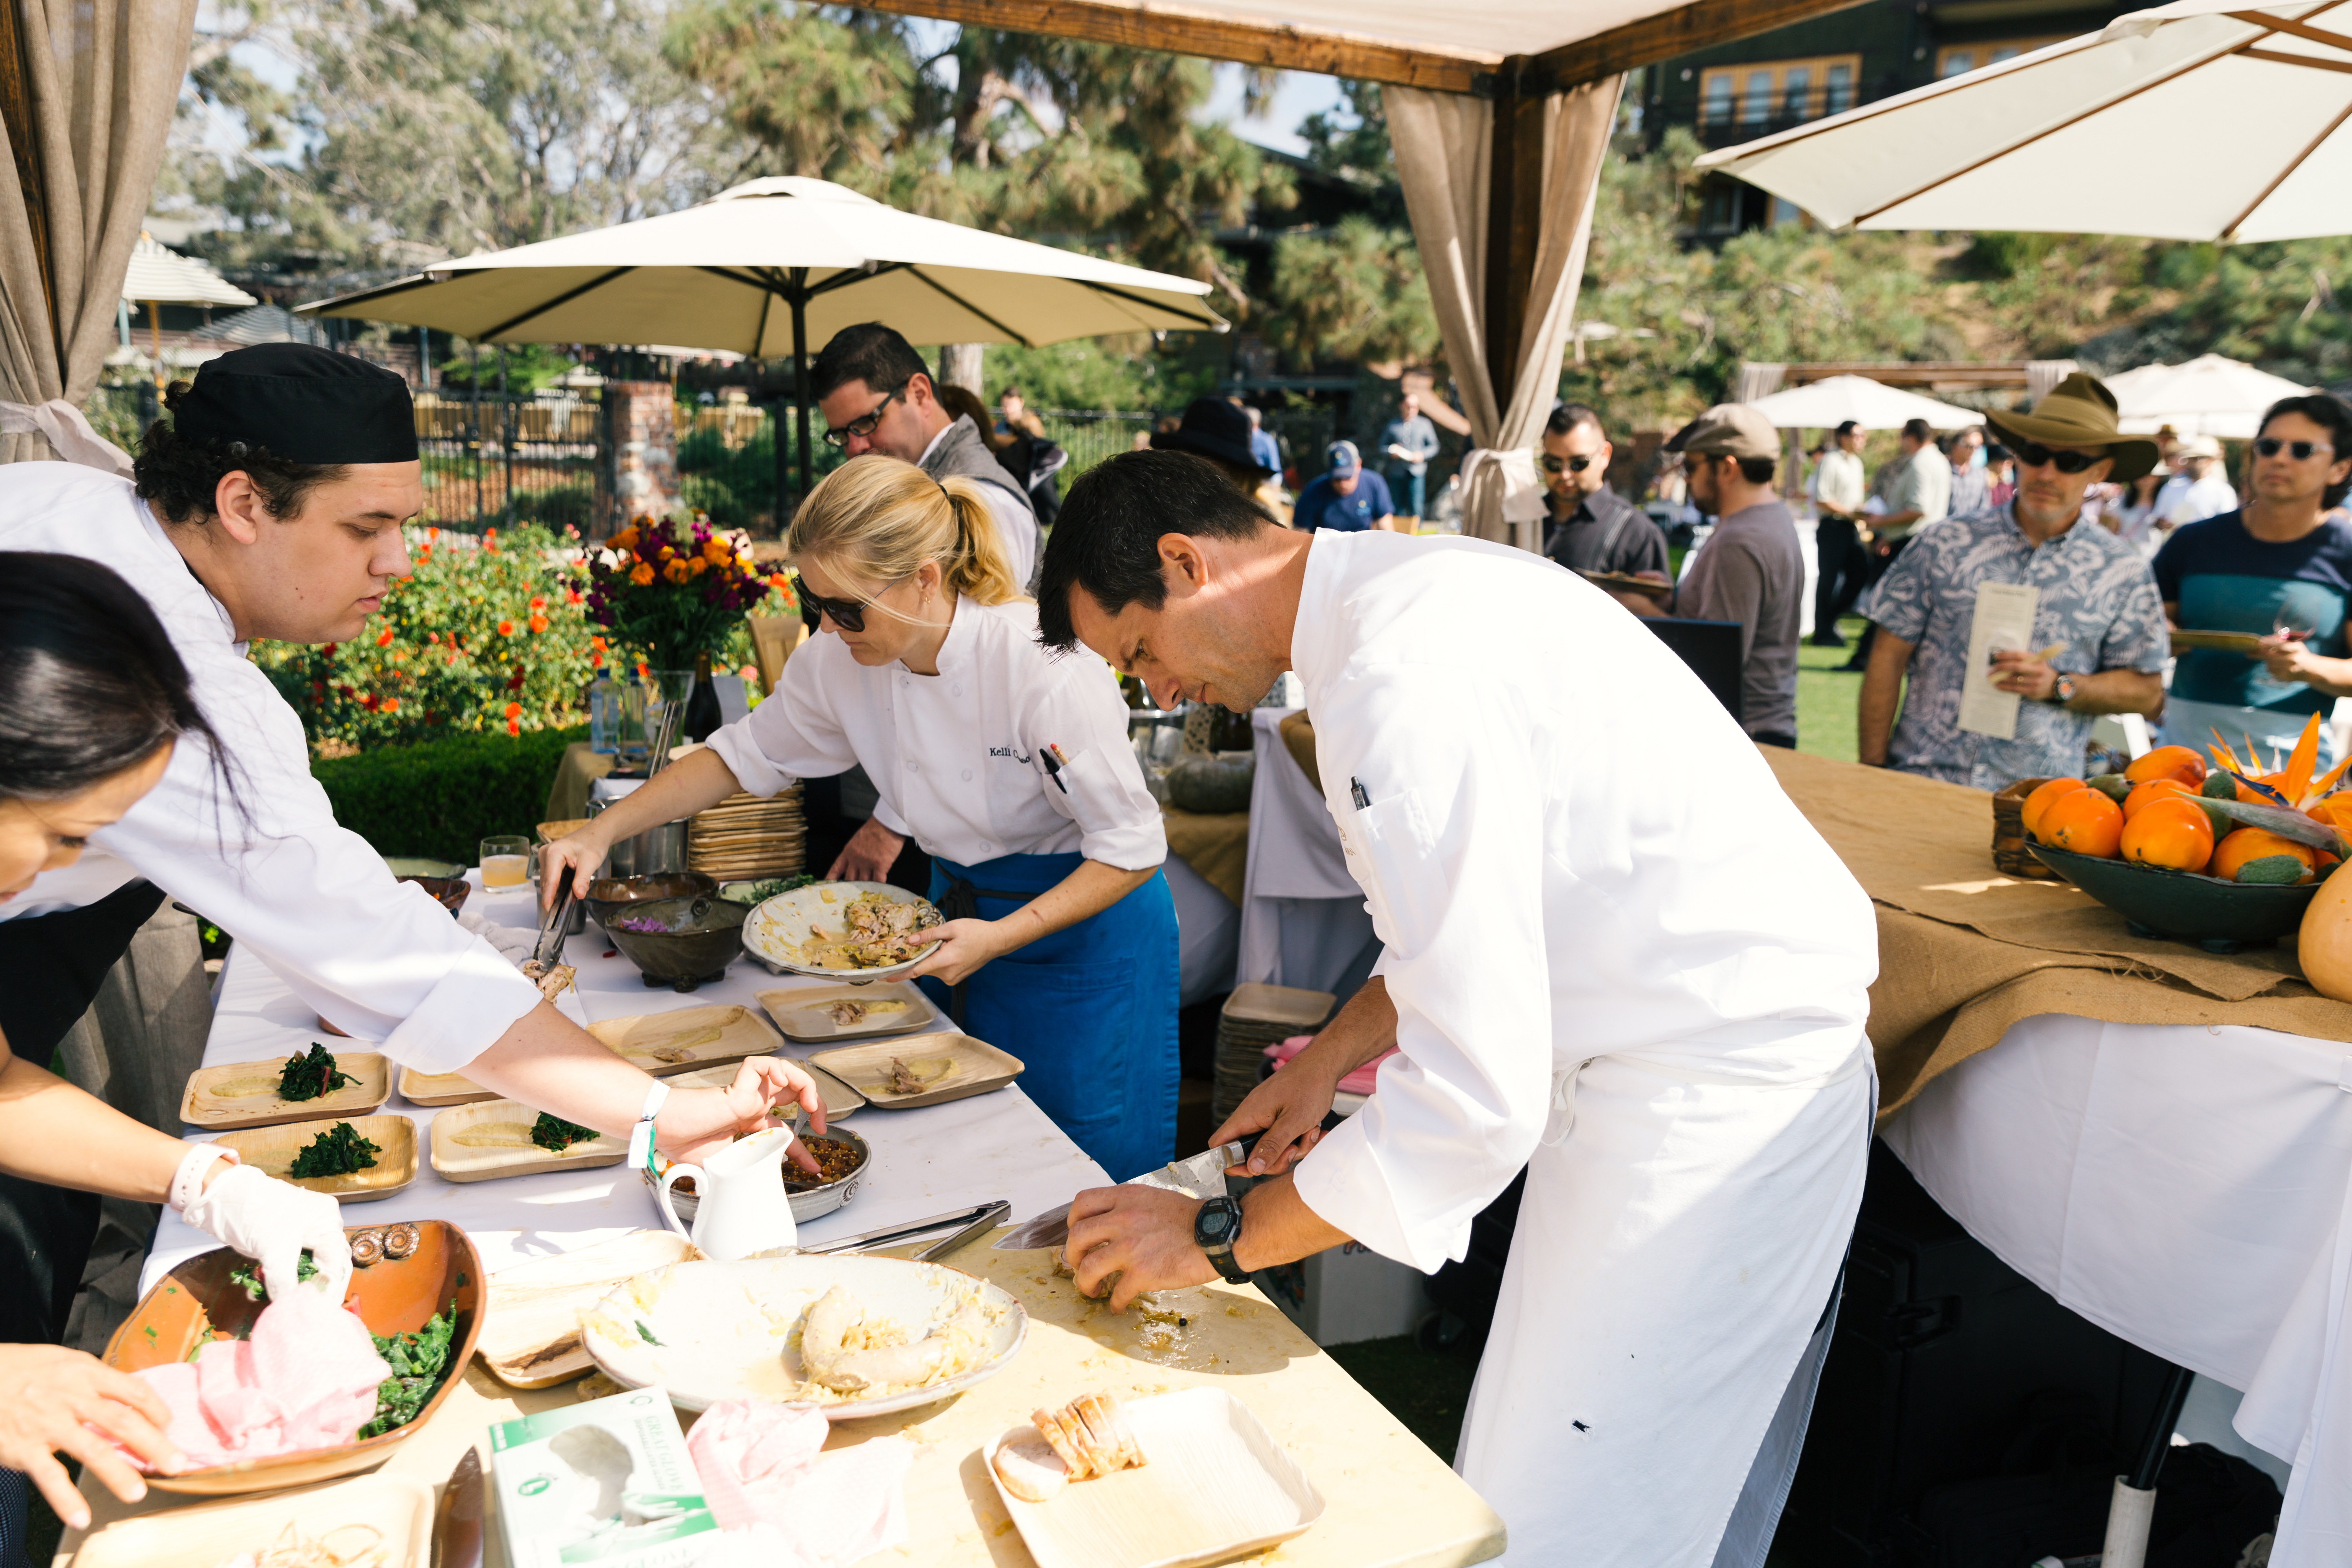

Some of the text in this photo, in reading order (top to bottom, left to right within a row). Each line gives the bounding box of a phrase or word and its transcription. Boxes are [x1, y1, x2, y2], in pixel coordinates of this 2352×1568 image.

[990, 747, 1011, 756] Kelli
[634, 1419, 666, 1490] DISPOSABLE LATEX GLOVES
[646, 1416, 685, 1491] GREAT GLOVE
